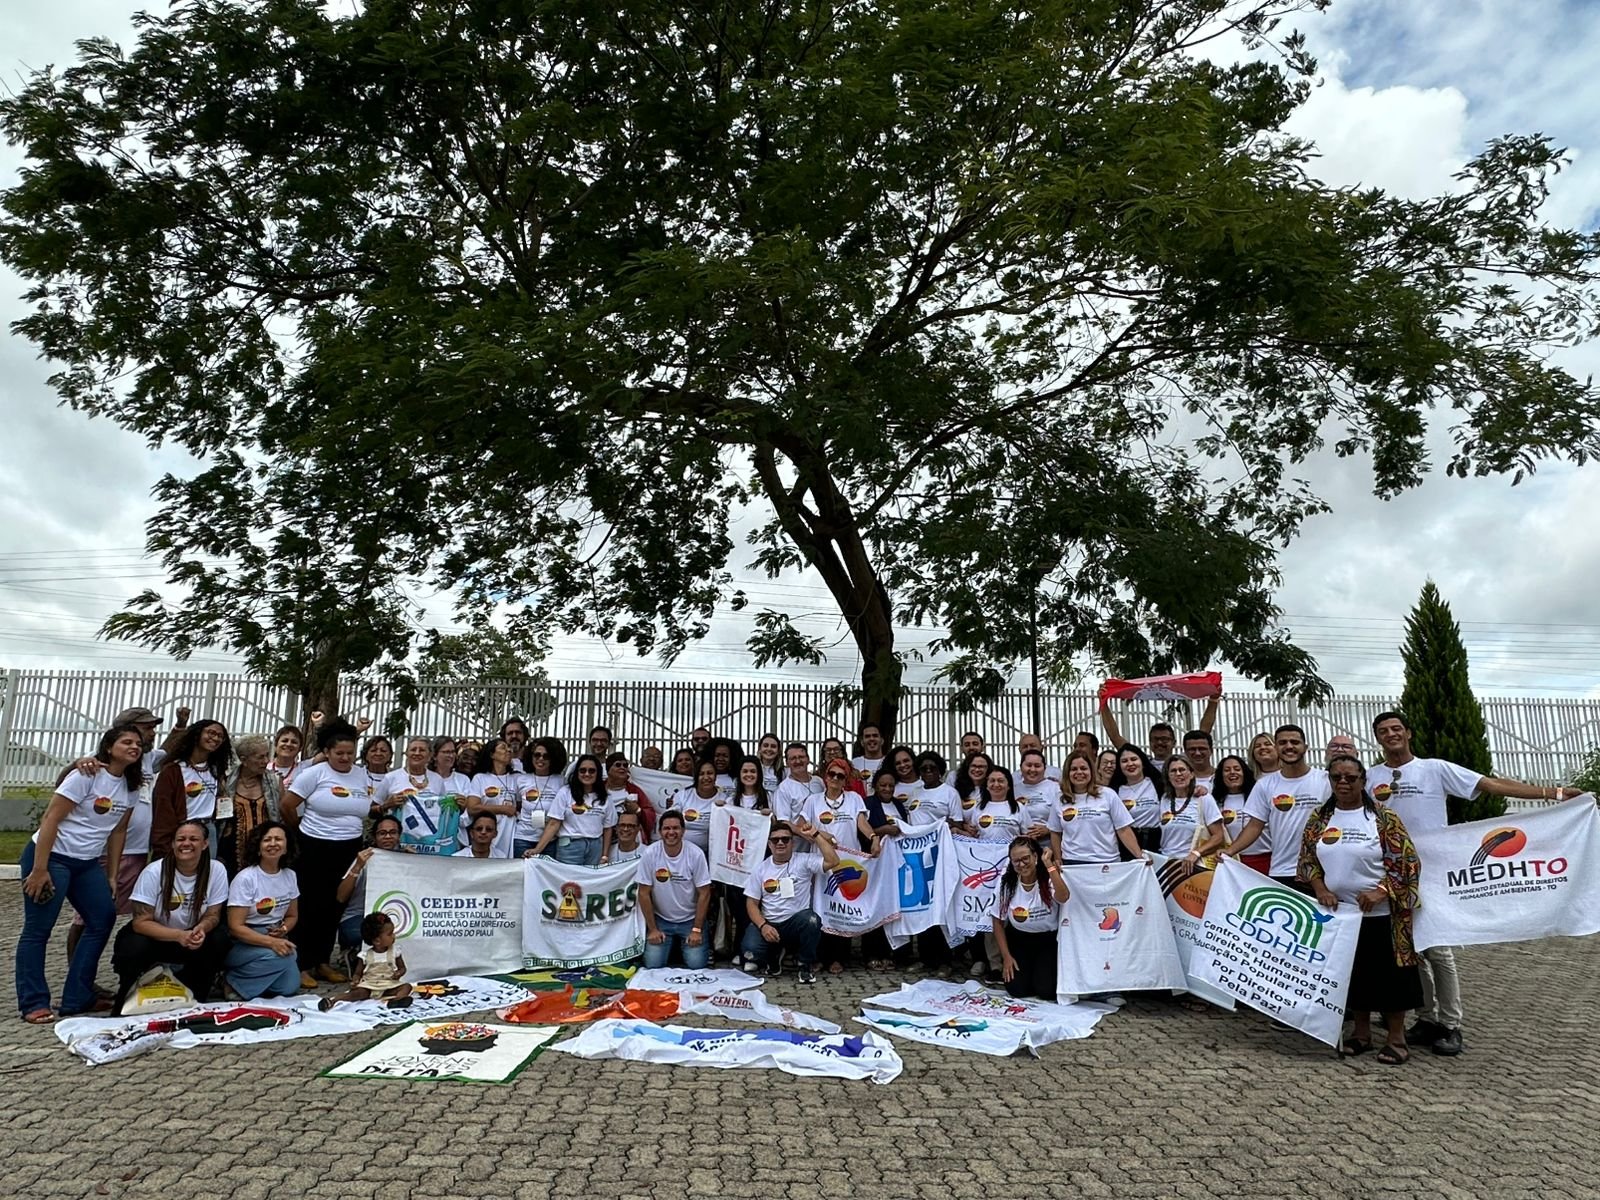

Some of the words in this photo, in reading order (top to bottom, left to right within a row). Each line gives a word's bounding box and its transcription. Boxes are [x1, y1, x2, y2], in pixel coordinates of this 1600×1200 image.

[1447, 857, 1568, 888] MEDHTO
[1449, 885, 1489, 896] MOVIMENTO
[1489, 880, 1524, 890] ESTADUAL
[1536, 875, 1568, 885] DIREITOS
[421, 897, 501, 909] CEEDH-PI
[422, 910, 453, 919] COMITÊ
[454, 911, 495, 919] ESTADUAL
[496, 911, 507, 919] DE
[829, 901, 863, 917] MNDH
[422, 919, 468, 929] EDUCAÇÃO
[470, 920, 481, 928] EM
[481, 920, 516, 929] DIREITOS
[422, 929, 463, 937] HUMANOS
[463, 929, 474, 937] DO
[1225, 912, 1327, 964] CDDHEP
[1203, 920, 1241, 942] Centro
[1243, 941, 1259, 954] de
[1262, 949, 1309, 976] Defesa
[1312, 973, 1339, 989] dos
[1205, 931, 1250, 959] Direitos
[1253, 957, 1317, 991] Humanos
[1320, 988, 1330, 996] e
[1212, 959, 1236, 976] Por
[1237, 972, 1298, 1009] Direitos!
[1218, 974, 1248, 998] Pela
[1250, 992, 1282, 1015] Paz!
[1240, 958, 1292, 991] Popular
[1294, 988, 1312, 1000] do
